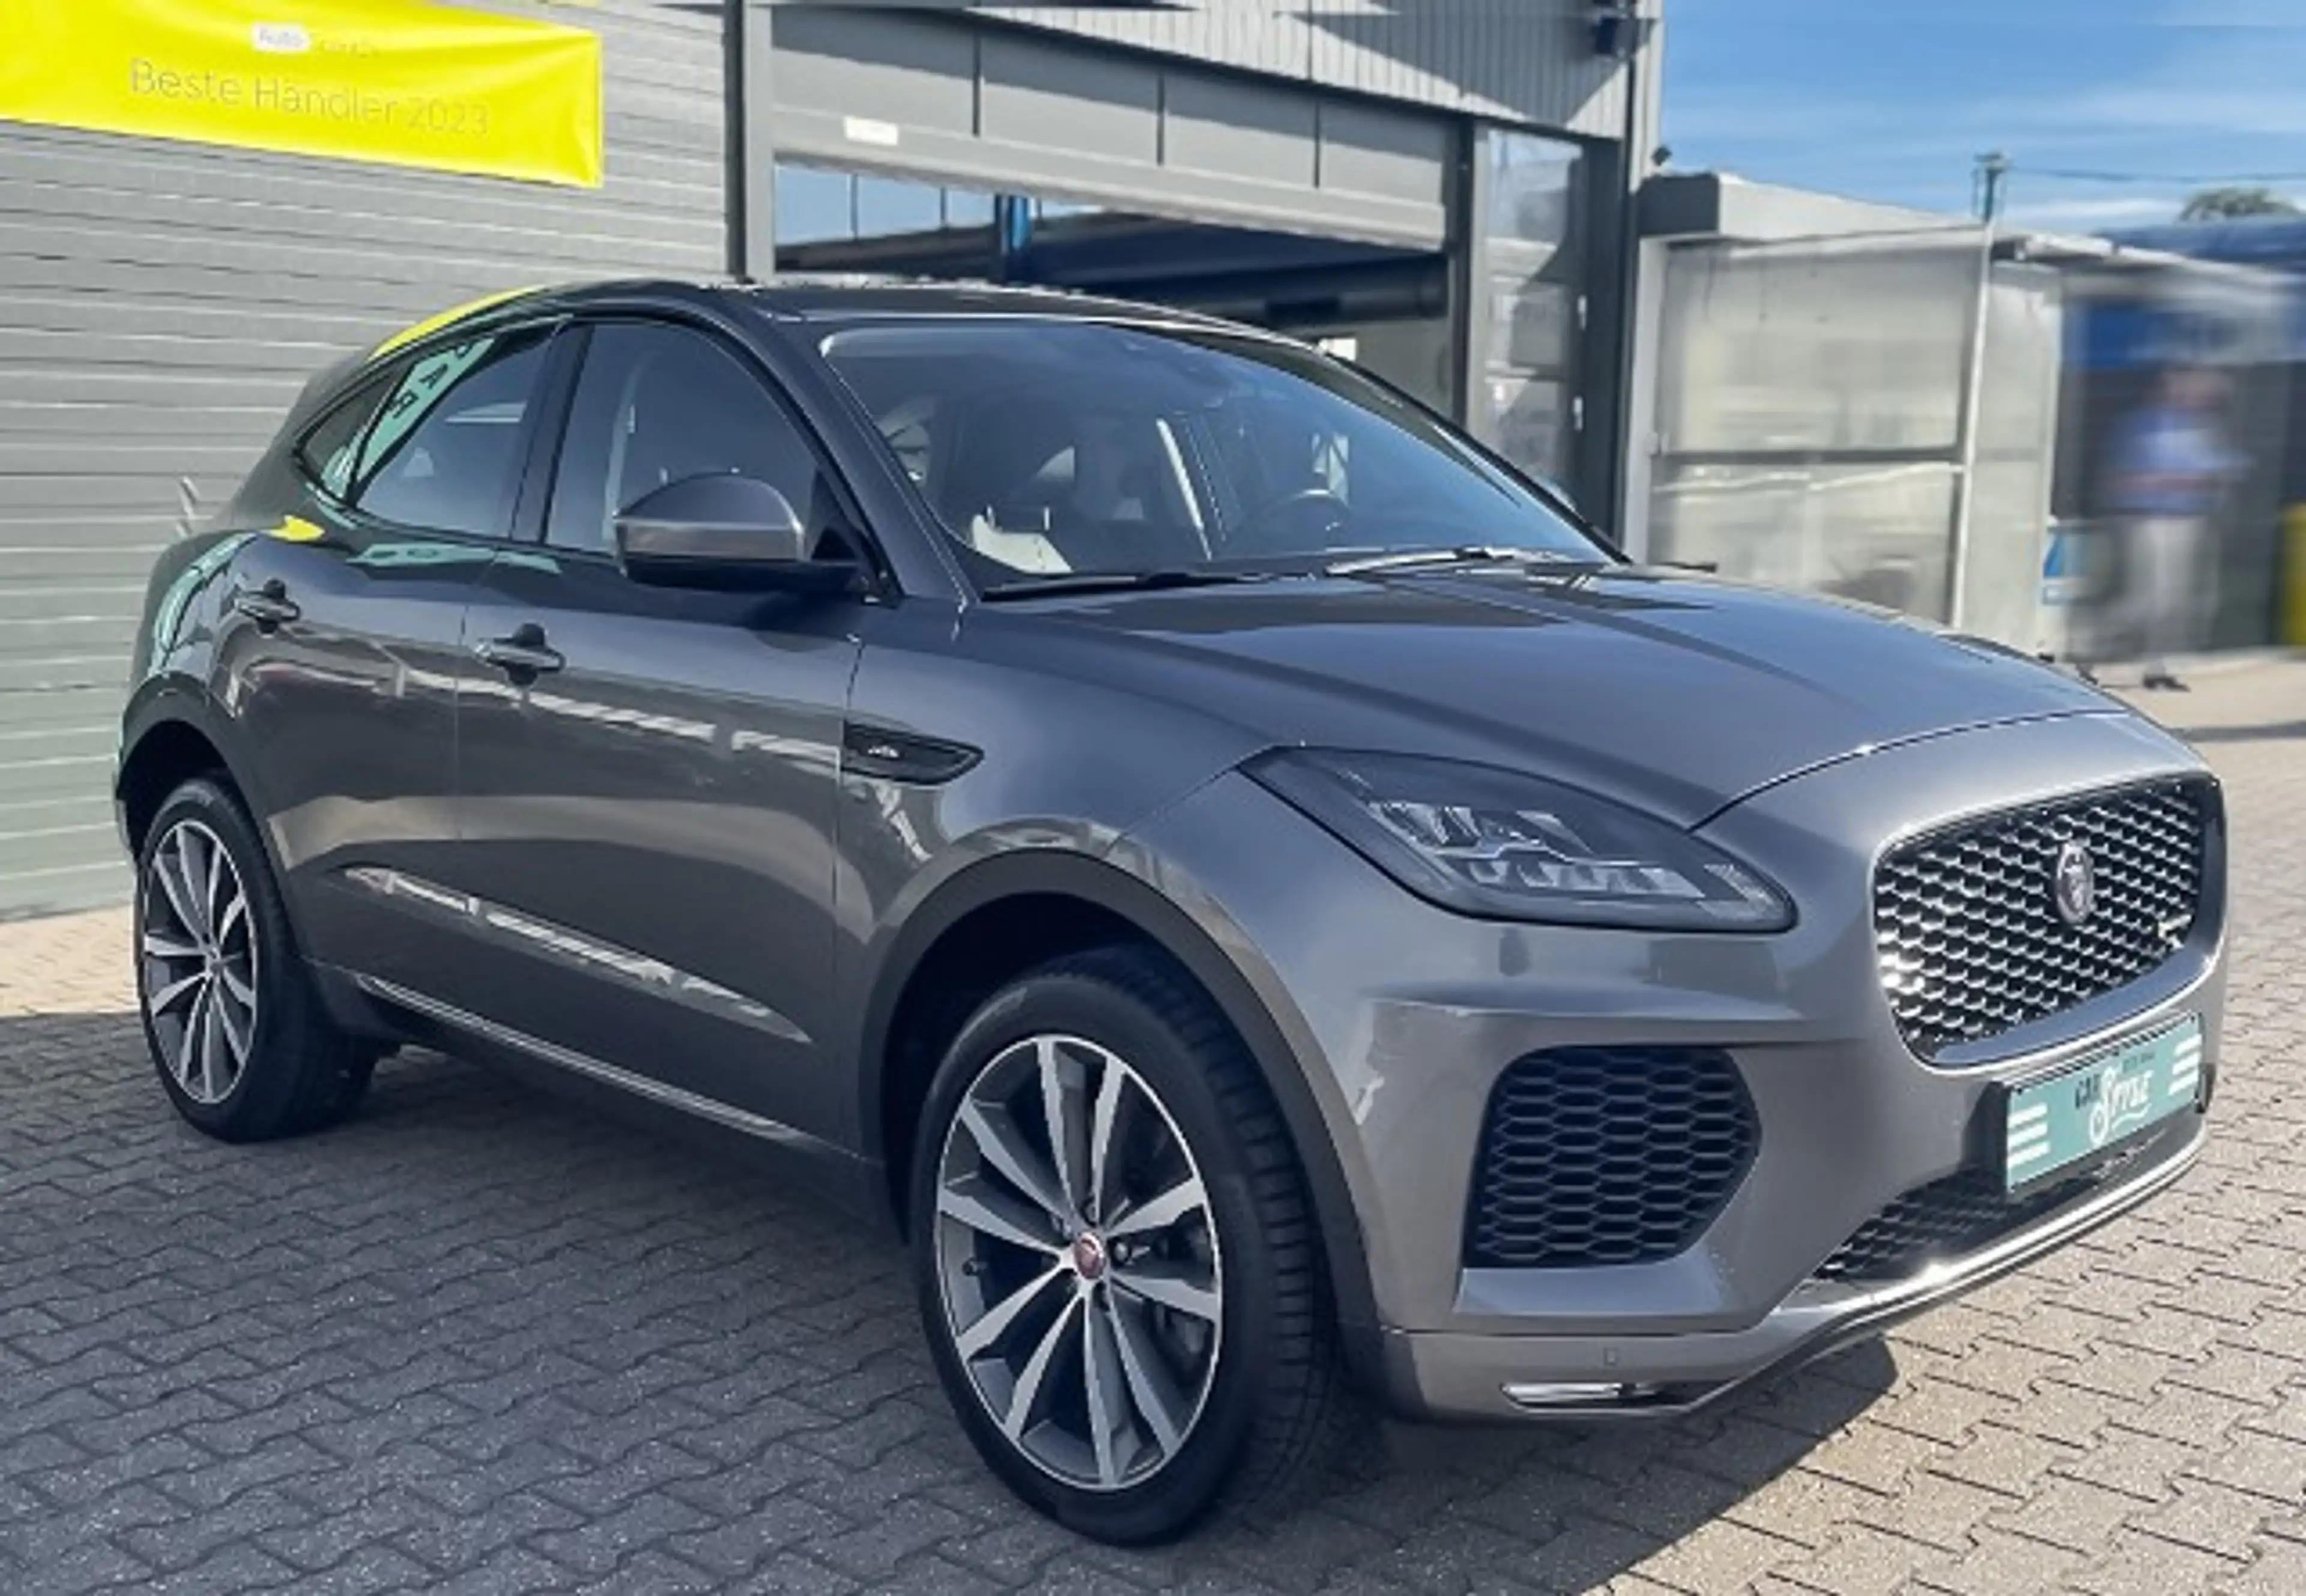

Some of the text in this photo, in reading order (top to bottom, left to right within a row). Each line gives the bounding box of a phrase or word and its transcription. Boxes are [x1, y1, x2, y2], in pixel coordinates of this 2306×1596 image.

[130, 57, 491, 136] Beste Händler 2023
